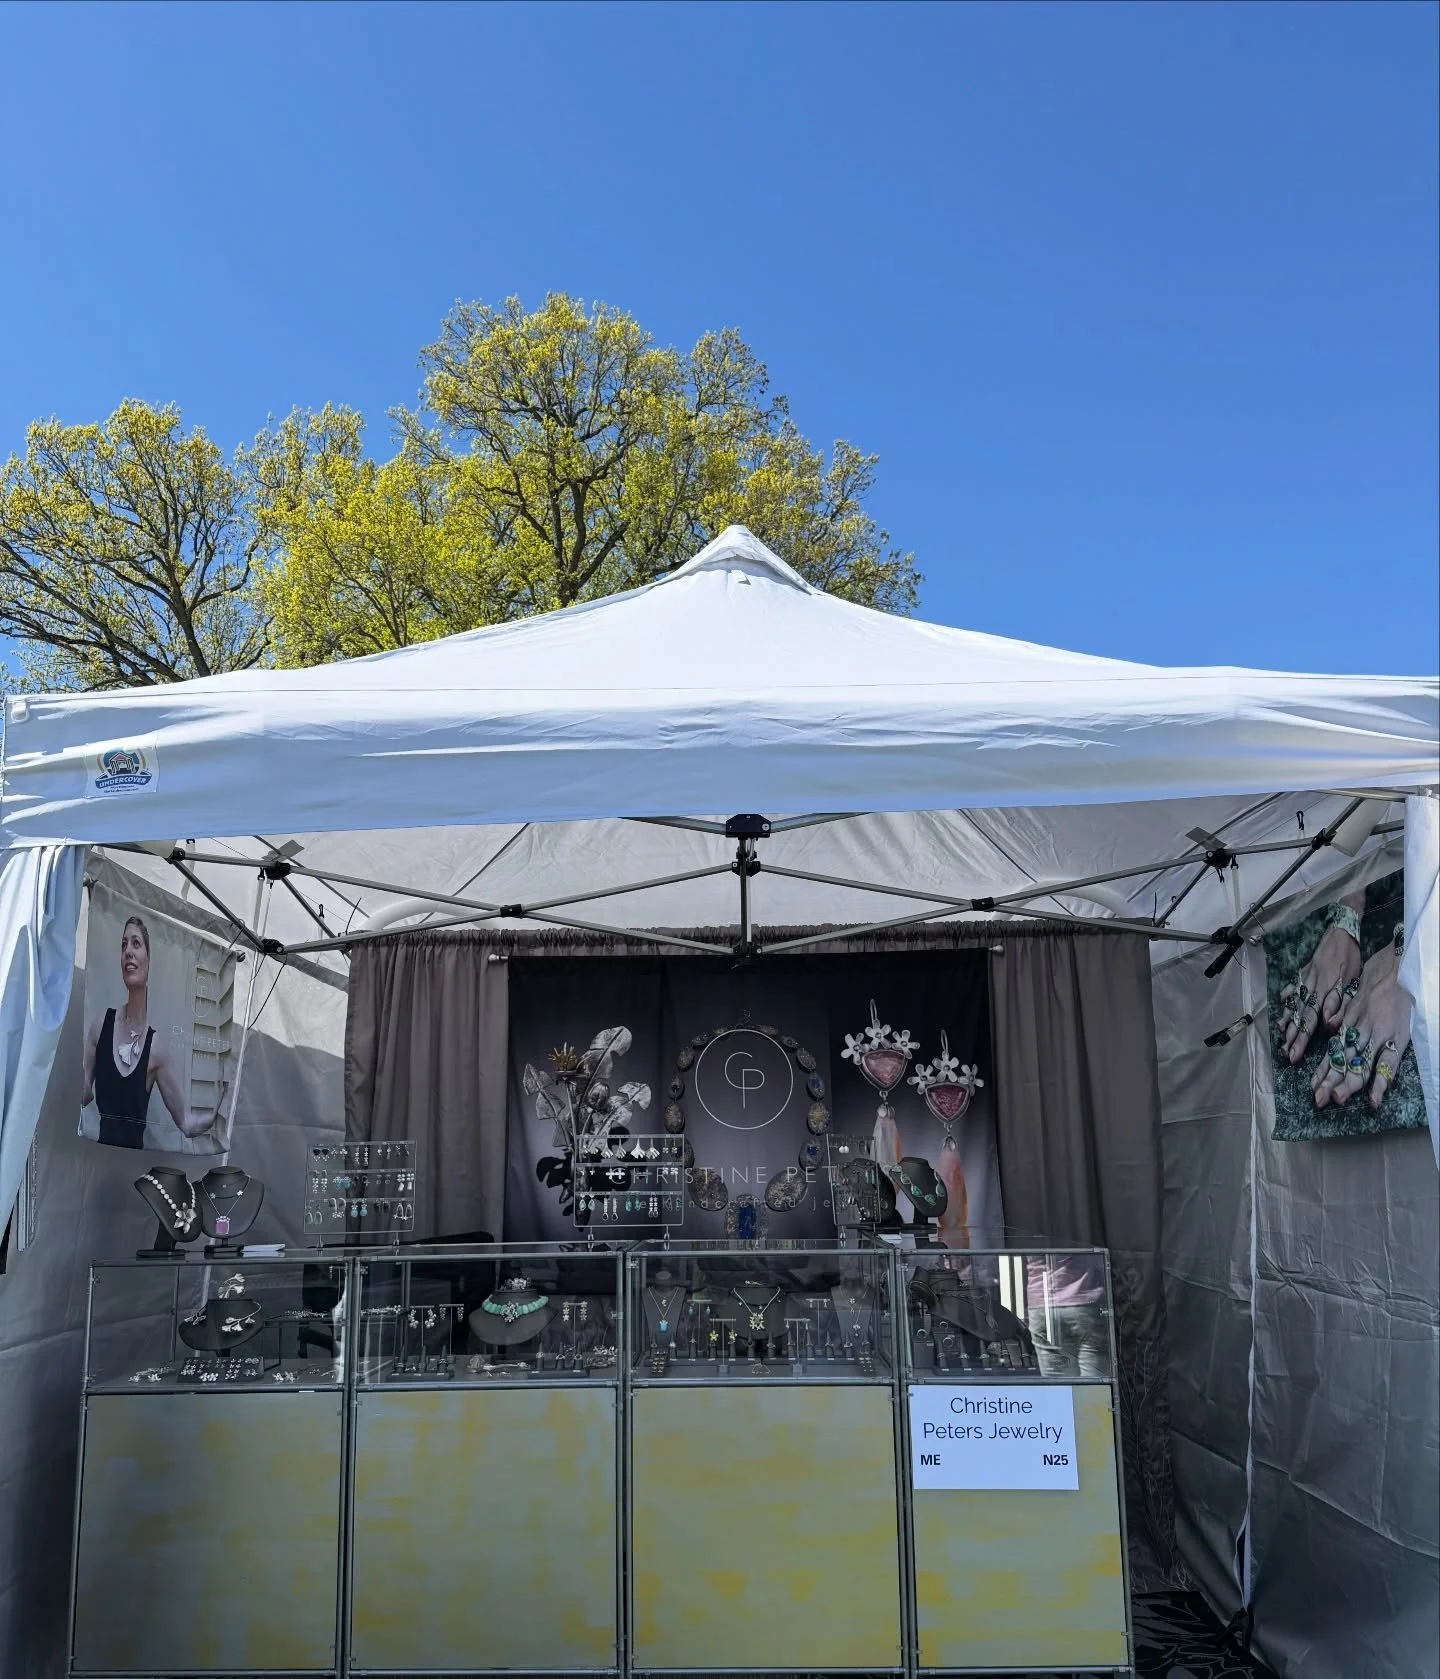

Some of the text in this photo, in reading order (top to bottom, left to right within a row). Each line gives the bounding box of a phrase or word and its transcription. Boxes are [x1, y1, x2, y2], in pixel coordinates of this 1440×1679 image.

[99, 776, 147, 788] UNDERCOVER
[610, 1166, 767, 1185] CHRISTINE
[950, 1397, 1033, 1414] Christine
[923, 1422, 1063, 1443] Peters Jewelry
[920, 1454, 1069, 1466] ME N25
